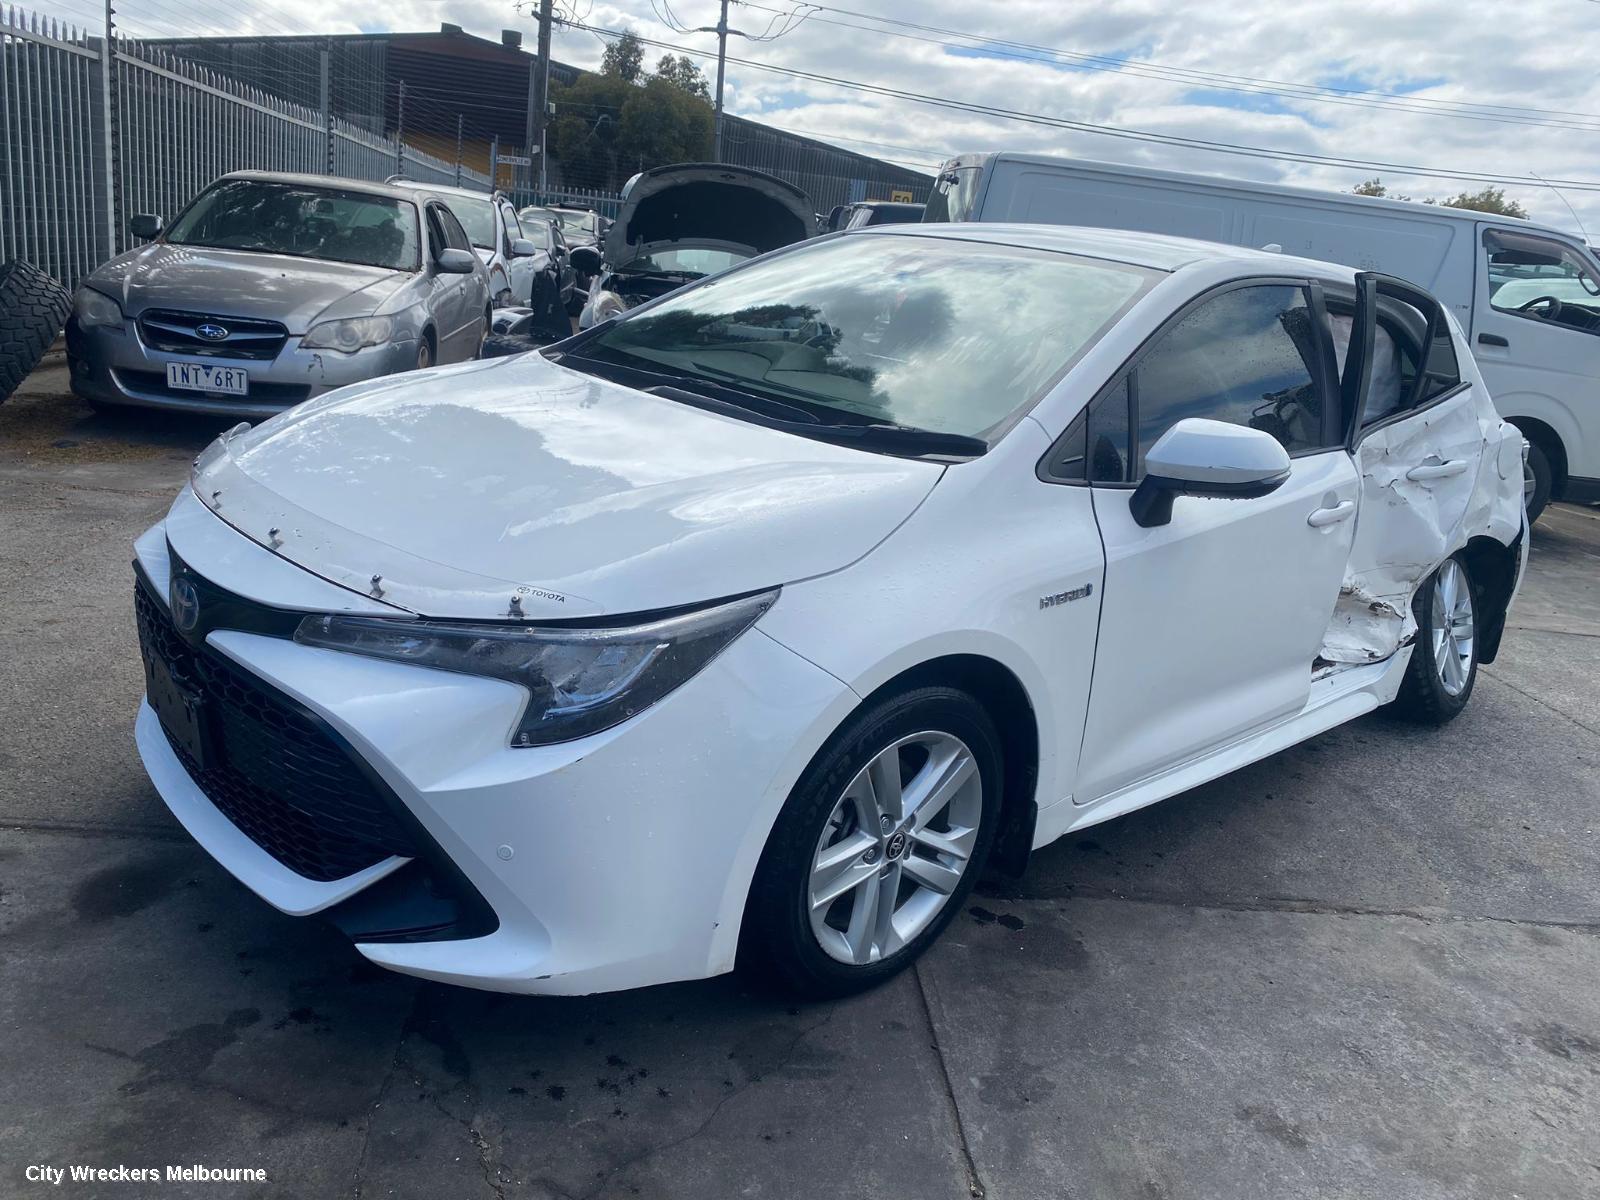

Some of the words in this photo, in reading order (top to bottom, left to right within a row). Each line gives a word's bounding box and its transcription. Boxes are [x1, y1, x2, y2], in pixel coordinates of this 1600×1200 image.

[171, 366, 200, 384] 1NT
[214, 371, 244, 389] 6RT
[531, 589, 565, 604] TOYOTA
